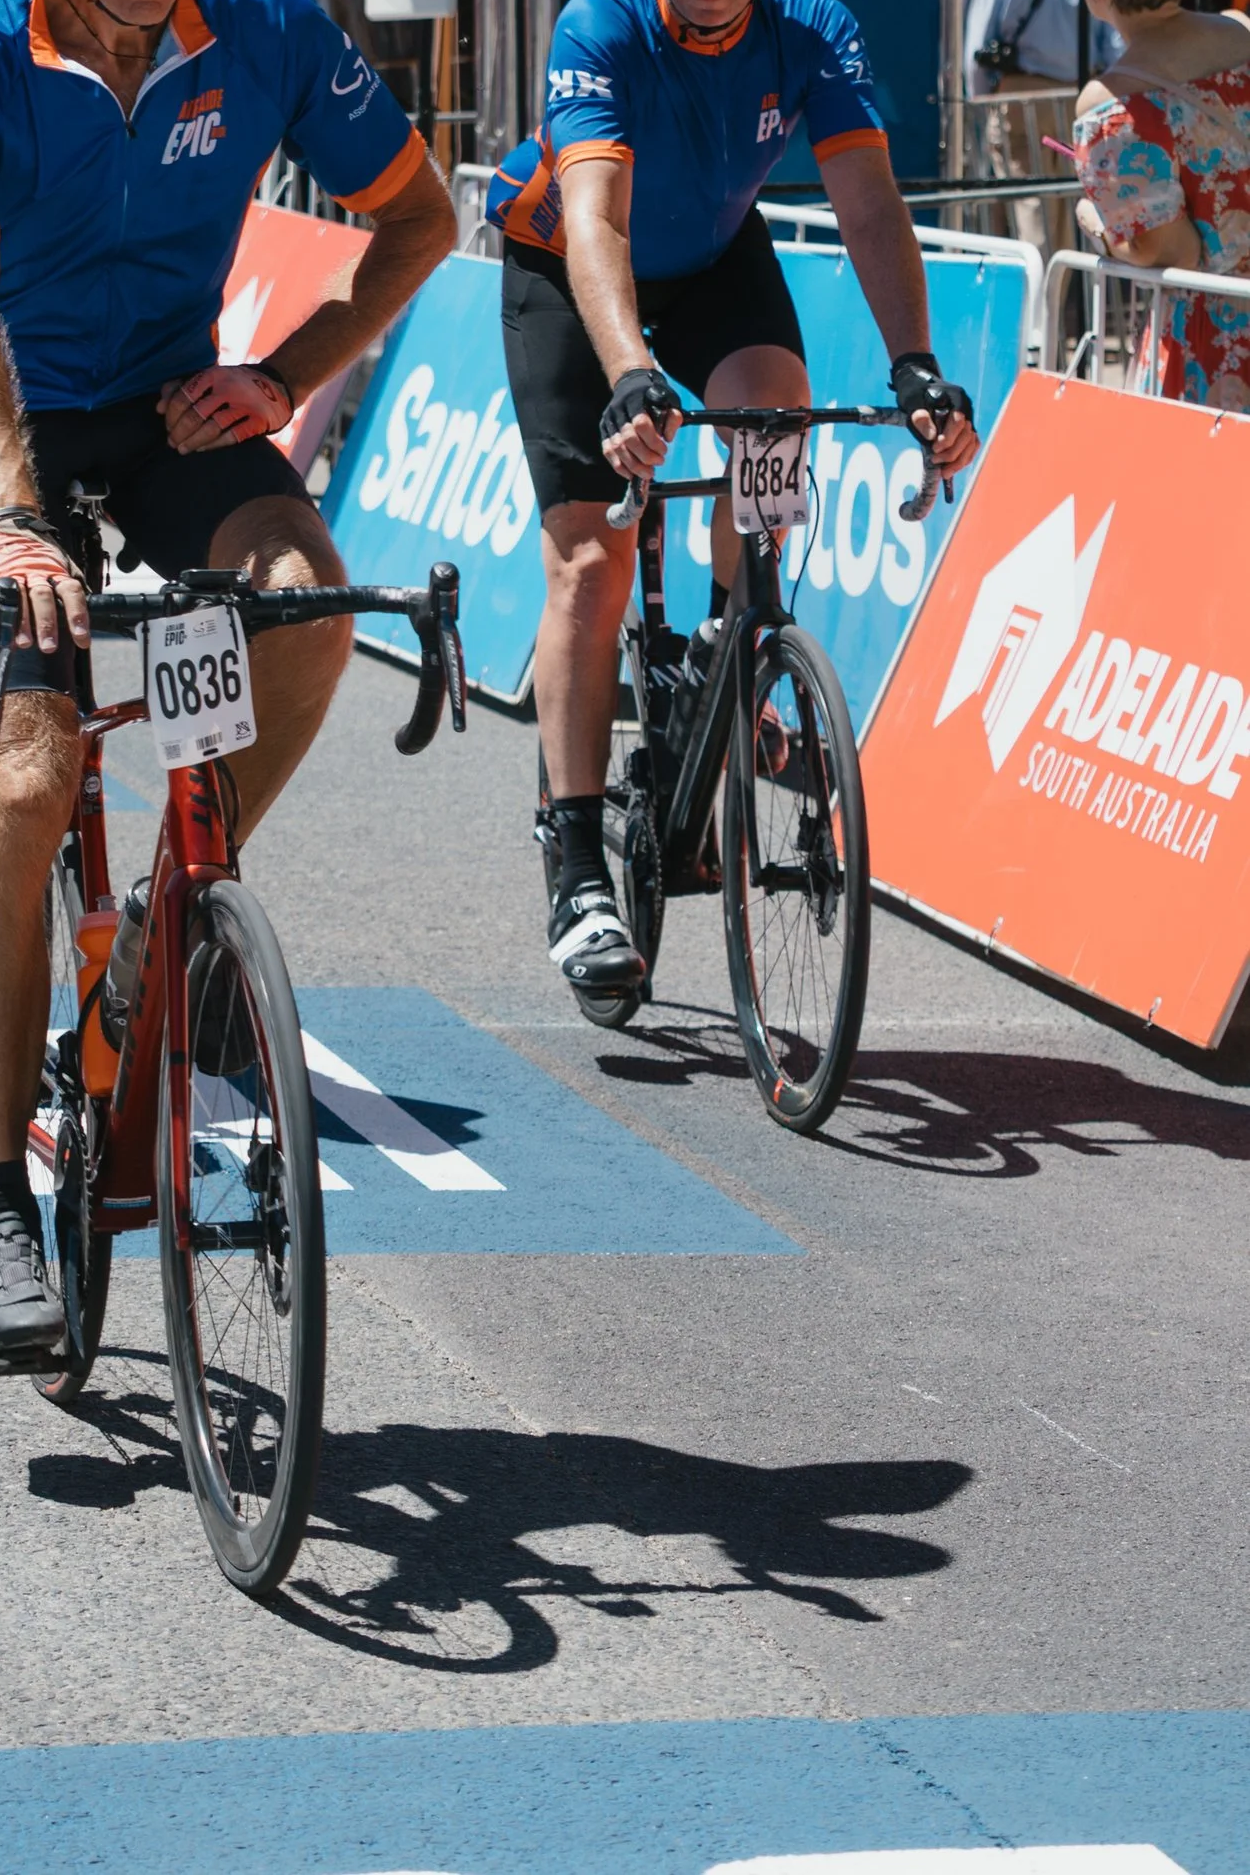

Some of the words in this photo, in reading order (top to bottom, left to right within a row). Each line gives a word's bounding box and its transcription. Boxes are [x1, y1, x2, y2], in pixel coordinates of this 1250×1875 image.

[161, 111, 221, 165] EPIC
[359, 364, 536, 557] Santos
[740, 456, 800, 498] 0384
[155, 649, 241, 719] 0836
[1043, 630, 1250, 801] ADELAIDE
[1019, 741, 1098, 811] SOUTH
[1087, 771, 1219, 864] AUSTRALIA
